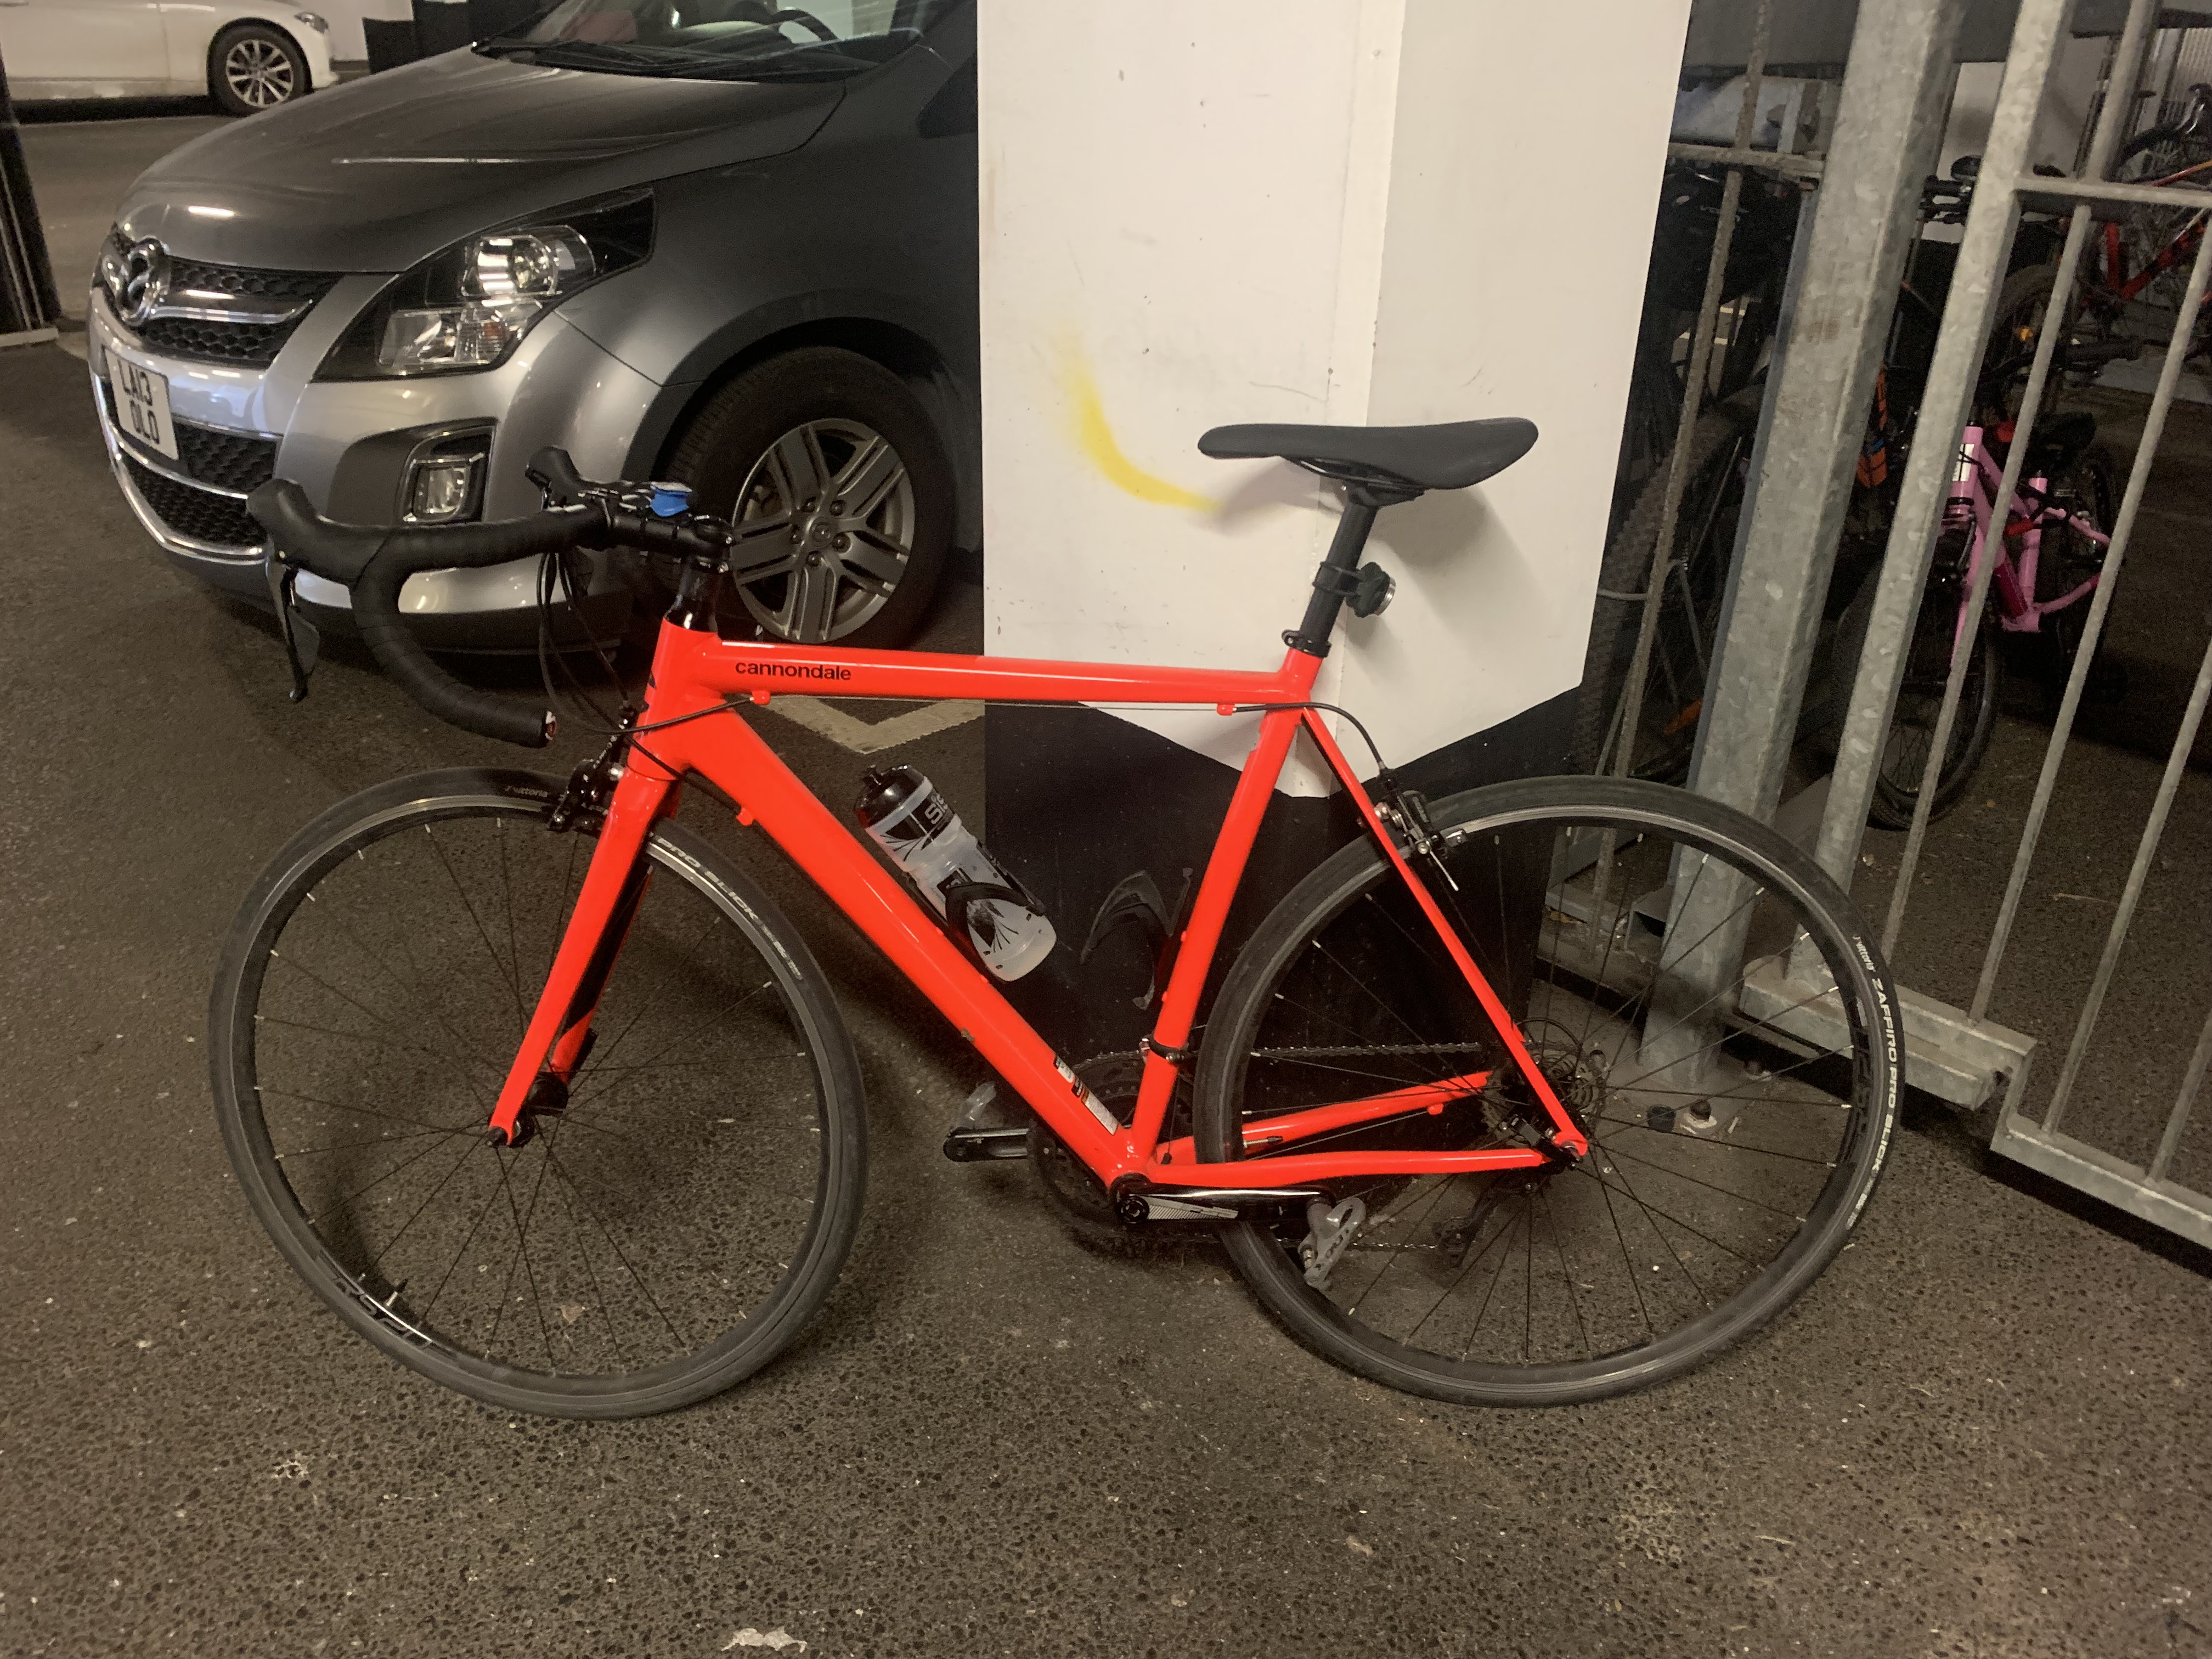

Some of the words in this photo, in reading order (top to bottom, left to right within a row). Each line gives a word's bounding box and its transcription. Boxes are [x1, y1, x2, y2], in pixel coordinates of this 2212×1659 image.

[735, 662, 851, 681] cannondale
[657, 837, 701, 868] PRO
[704, 870, 758, 920] SLICK
[1871, 978, 1898, 1063] ZAFFIRO
[1888, 1066, 1898, 1108] PRO
[1871, 1114, 1893, 1173] SLICK
